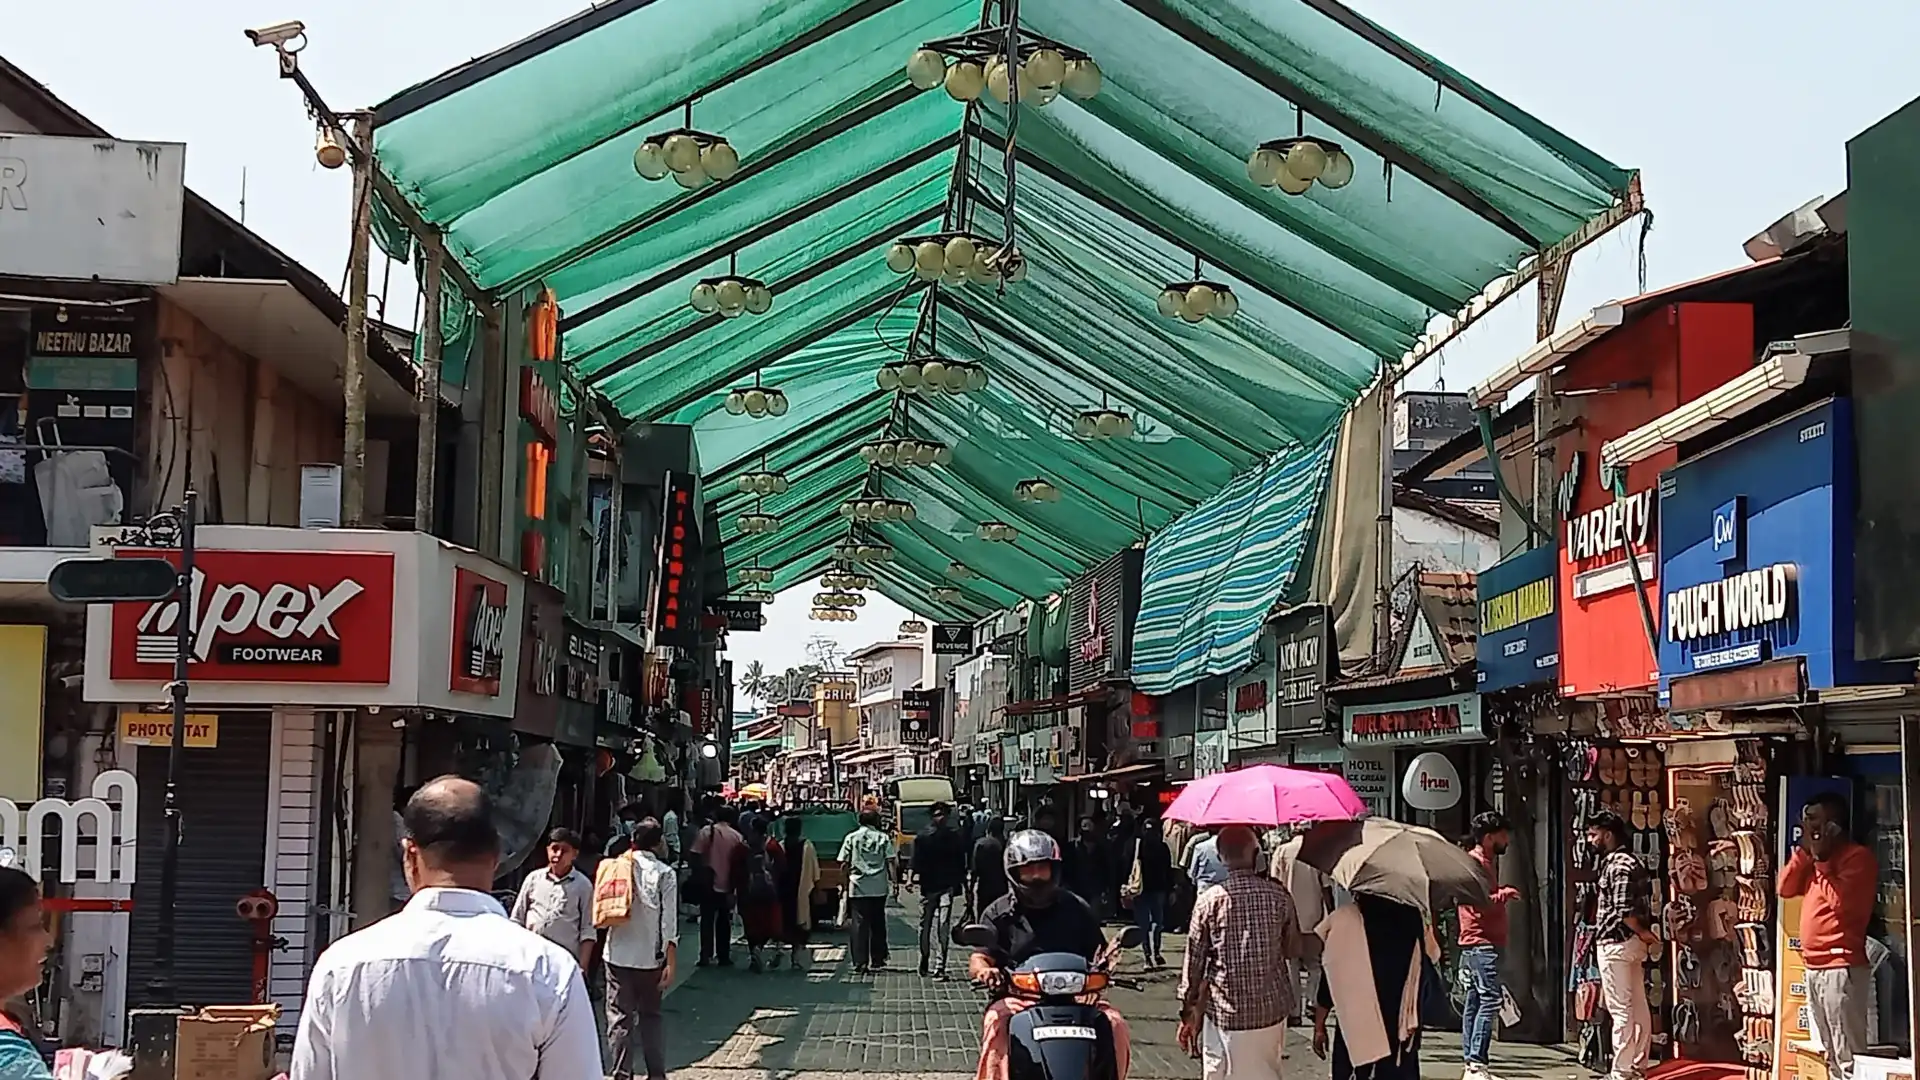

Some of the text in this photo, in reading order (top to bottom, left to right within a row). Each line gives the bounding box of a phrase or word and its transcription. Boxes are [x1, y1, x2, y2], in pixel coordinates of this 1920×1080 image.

[36, 331, 132, 353] NEETHU BAZAR
[1567, 488, 1652, 563] VARIETY
[1667, 564, 1787, 643] POUCH WORLD
[231, 647, 323, 662] FOOTWEAR
[824, 688, 857, 700] GRIH
[127, 722, 210, 738] PHOTOTAT
[902, 731, 928, 740] LULU
[1349, 760, 1384, 771] HOTEL
